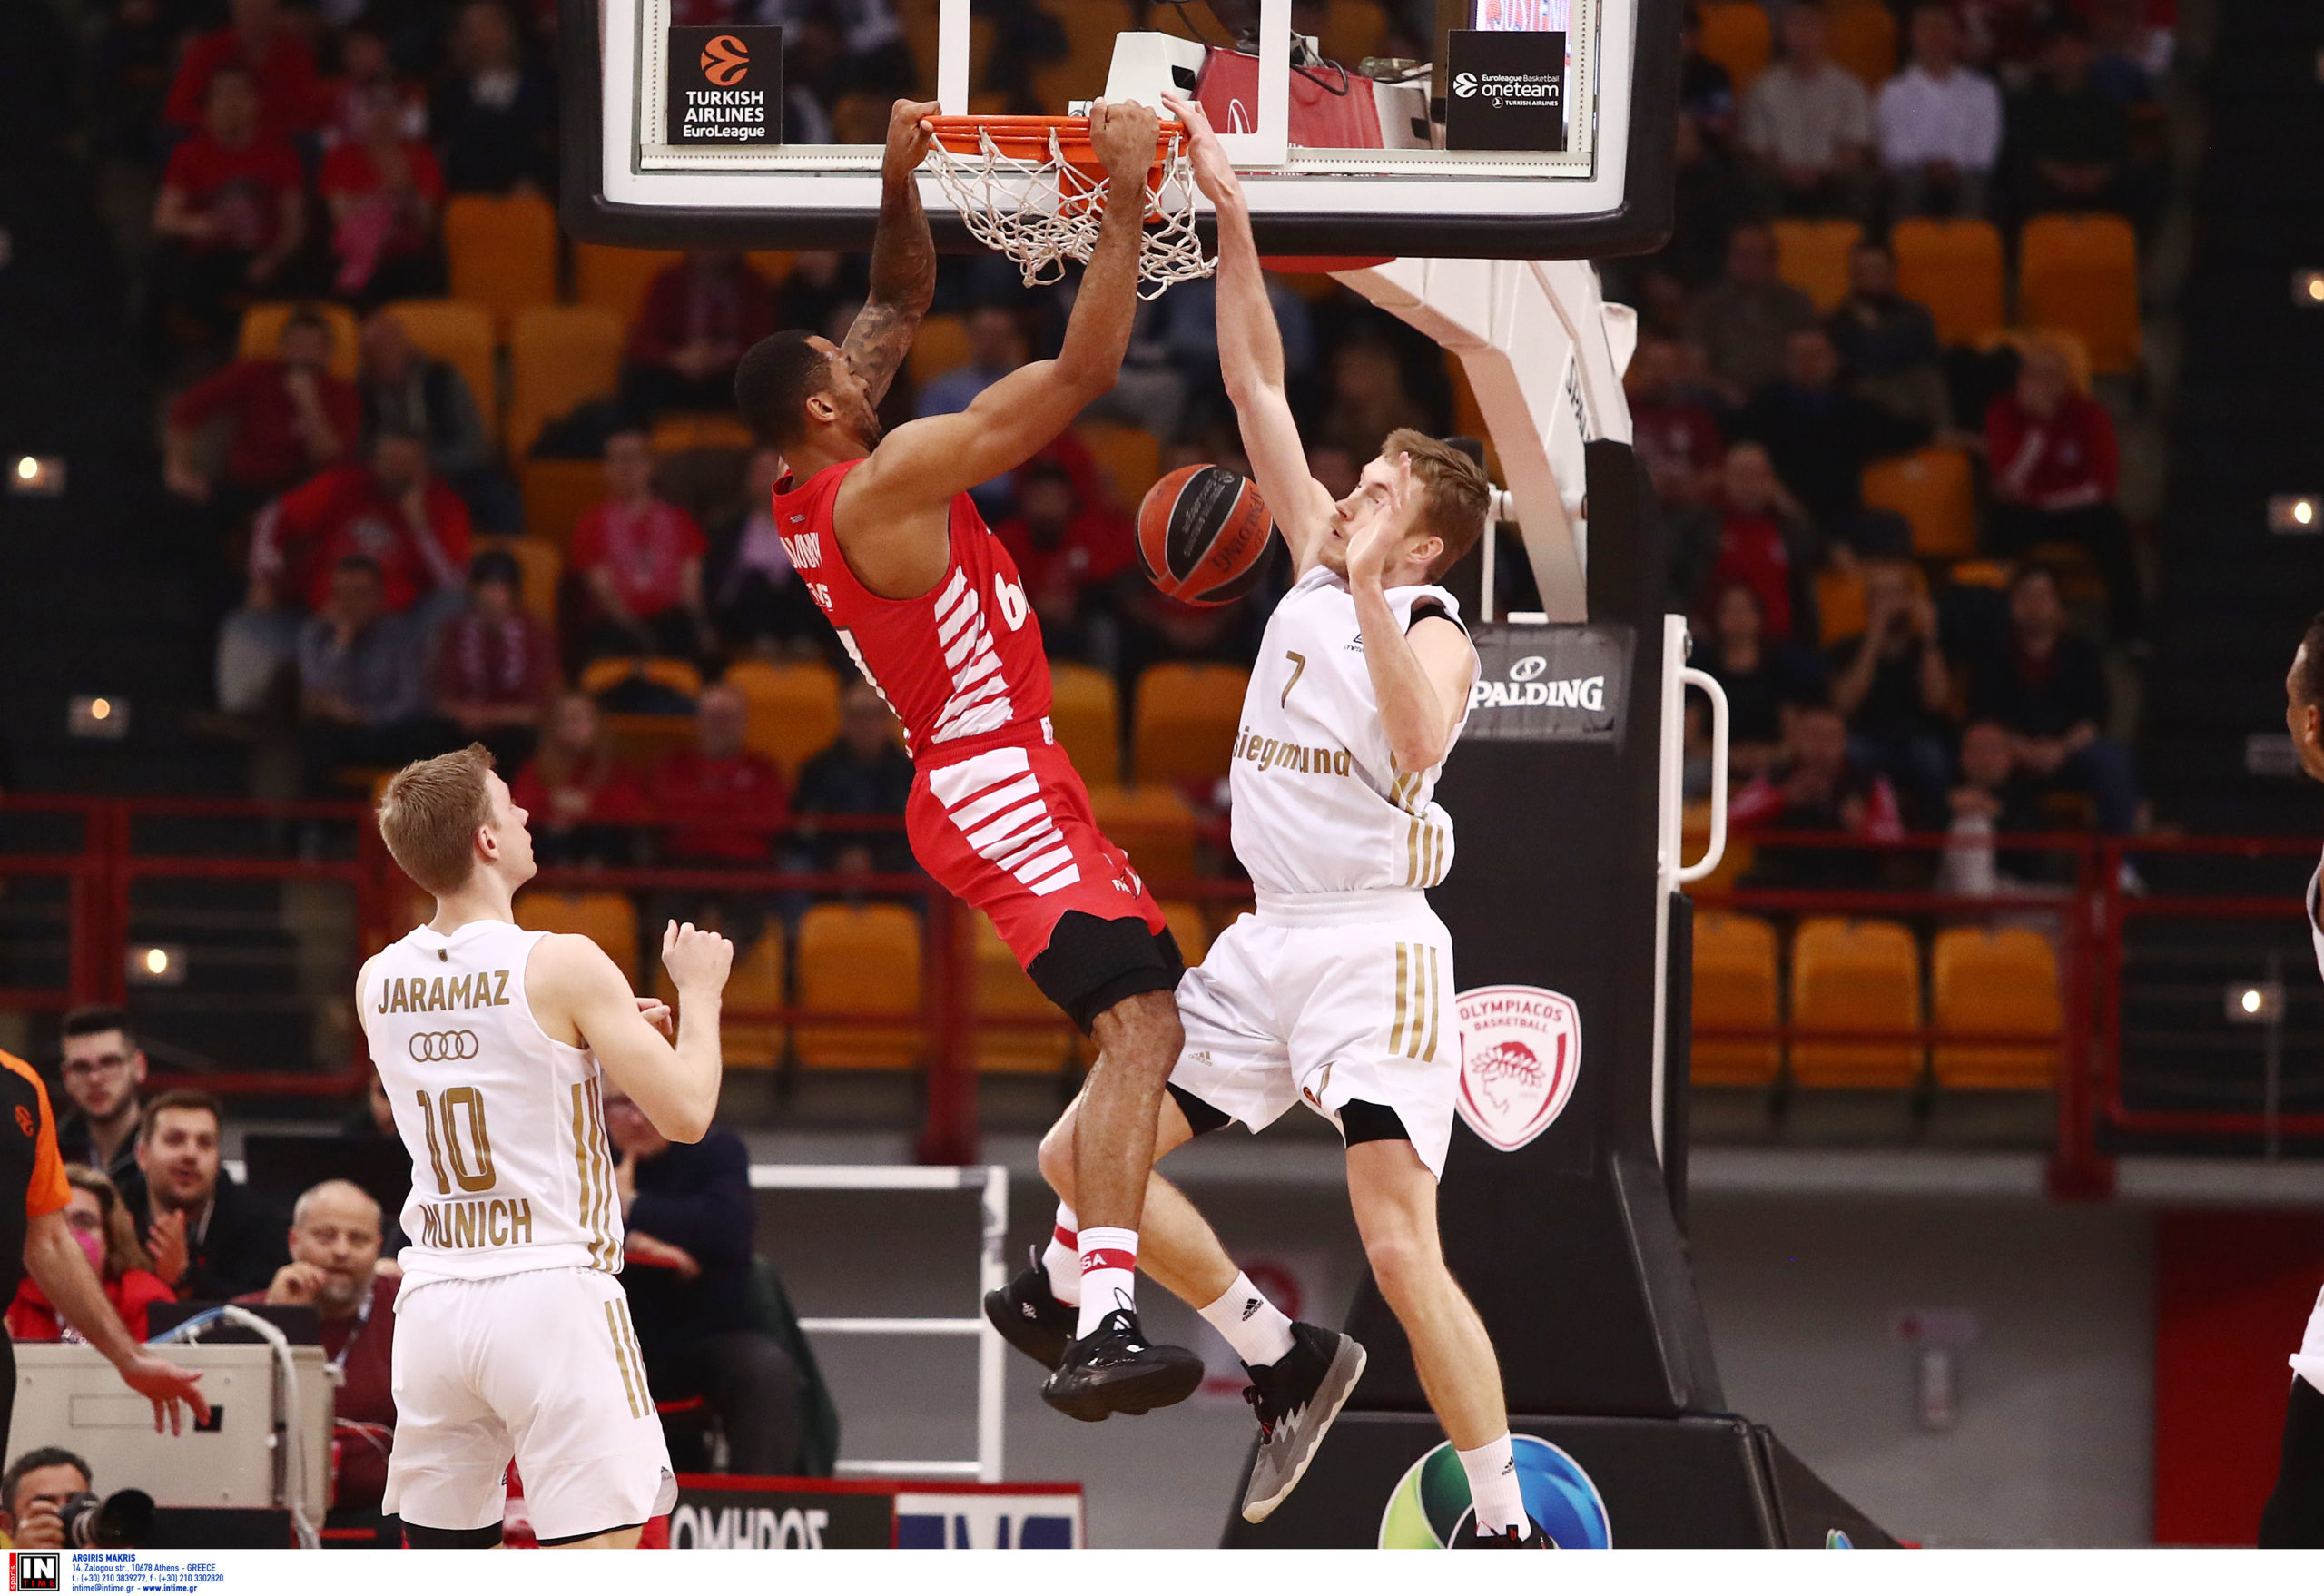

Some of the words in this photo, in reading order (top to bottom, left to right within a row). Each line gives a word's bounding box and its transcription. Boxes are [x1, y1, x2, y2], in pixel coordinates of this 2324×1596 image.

[1482, 74, 1522, 84] Euroleague
[1522, 74, 1560, 83] Basketball
[685, 90, 764, 105] TURKISH
[1482, 83, 1559, 97] oneteam
[684, 107, 765, 123] AIRLINES
[683, 124, 765, 141] EuroLeague
[1281, 649, 1306, 710] 7
[1470, 675, 1605, 712] PALDING
[378, 970, 510, 1015] JARAMAZ
[1460, 1000, 1563, 1022] OLYMPIACOS
[1474, 1018, 1547, 1034] BASKETBALL
[416, 1086, 497, 1195] 10
[419, 1197, 533, 1249] MUNICH
[1080, 1253, 1108, 1270] SA
[1242, 1299, 1264, 1322] adidas
